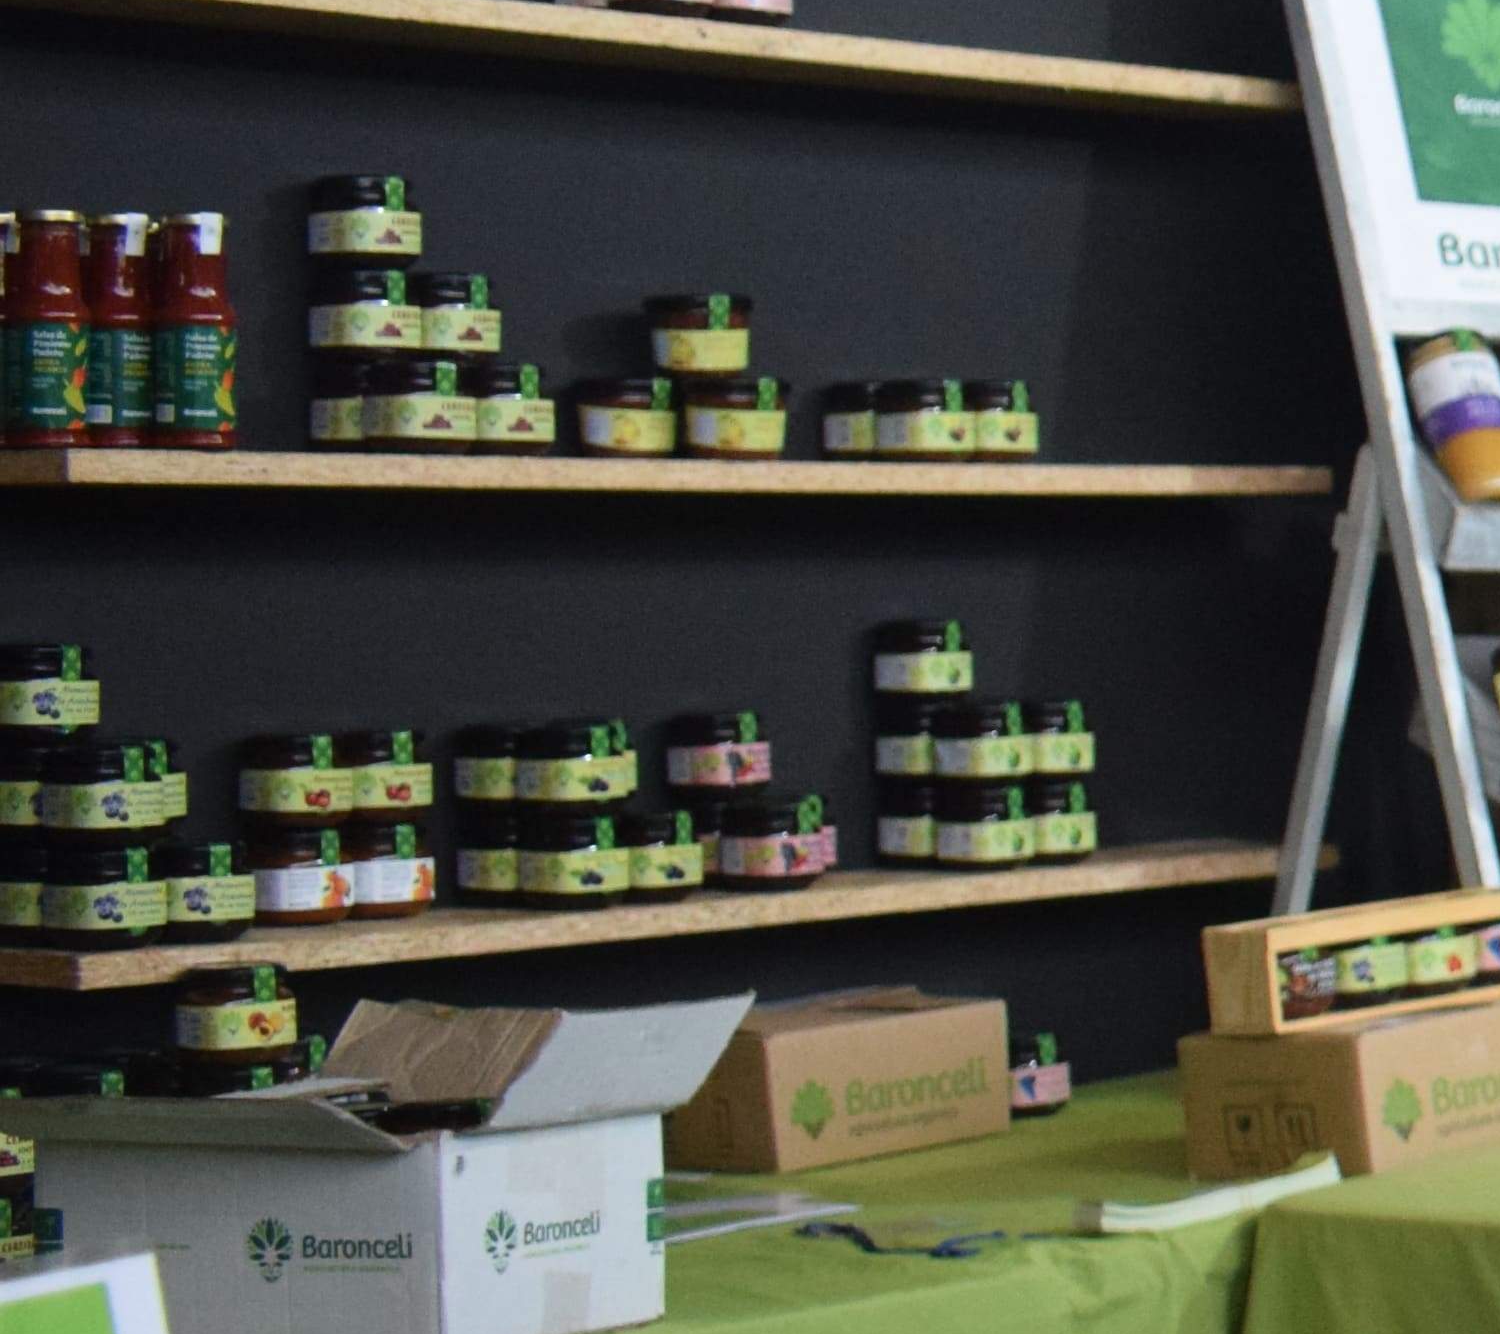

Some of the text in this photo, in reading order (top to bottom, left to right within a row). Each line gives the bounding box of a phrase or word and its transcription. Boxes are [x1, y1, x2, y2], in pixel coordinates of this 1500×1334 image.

[845, 1057, 986, 1117] Baronceli
[523, 1211, 602, 1245] Baronceli
[301, 1233, 413, 1261] Baronceli
